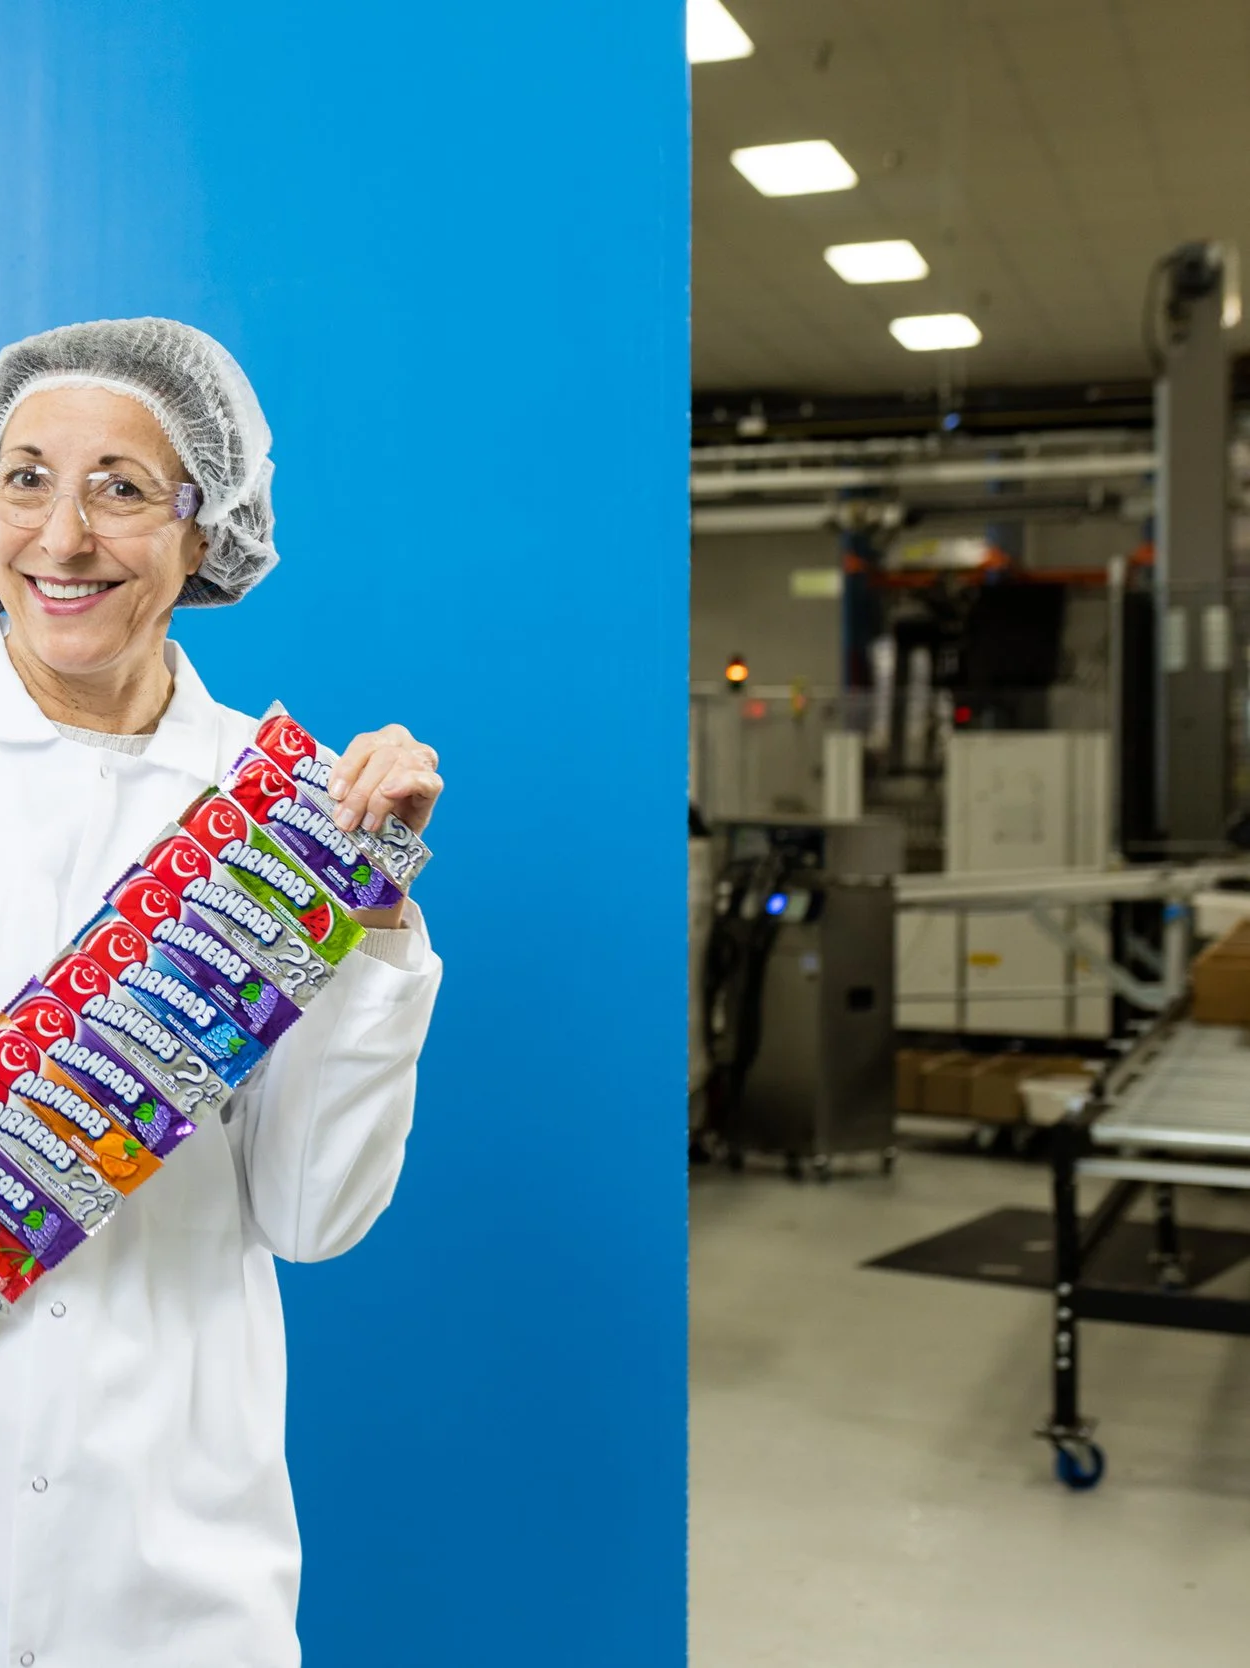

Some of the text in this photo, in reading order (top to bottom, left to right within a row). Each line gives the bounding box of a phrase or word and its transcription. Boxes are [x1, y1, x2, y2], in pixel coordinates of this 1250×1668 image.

[266, 796, 362, 866] AIRHEADS
[217, 838, 317, 907] AIRHEADS
[326, 866, 350, 887] GRAPE
[181, 876, 283, 944] AIRHEADS
[269, 895, 311, 937] WATERMELON
[151, 917, 252, 984] AIRHEADS
[232, 931, 254, 952] WHITE
[252, 949, 281, 974] MYSTERY
[118, 961, 217, 1028] AIRHEADS
[215, 984, 238, 1006] GRAPE
[80, 993, 182, 1061] AIRHEADS
[165, 1013, 184, 1031] BLUE
[182, 1028, 219, 1061] RASPBERRY
[45, 1036, 145, 1104] AIRHEADS
[131, 1047, 153, 1069] WHITE
[151, 1066, 179, 1092] MYSTERY
[10, 1070, 111, 1138] AIRHEADS
[109, 1103, 131, 1126] GRAPE
[71, 1134, 99, 1162] ORANGE
[26, 1155, 48, 1178] WHITE
[47, 1175, 73, 1201] MYSTERY
